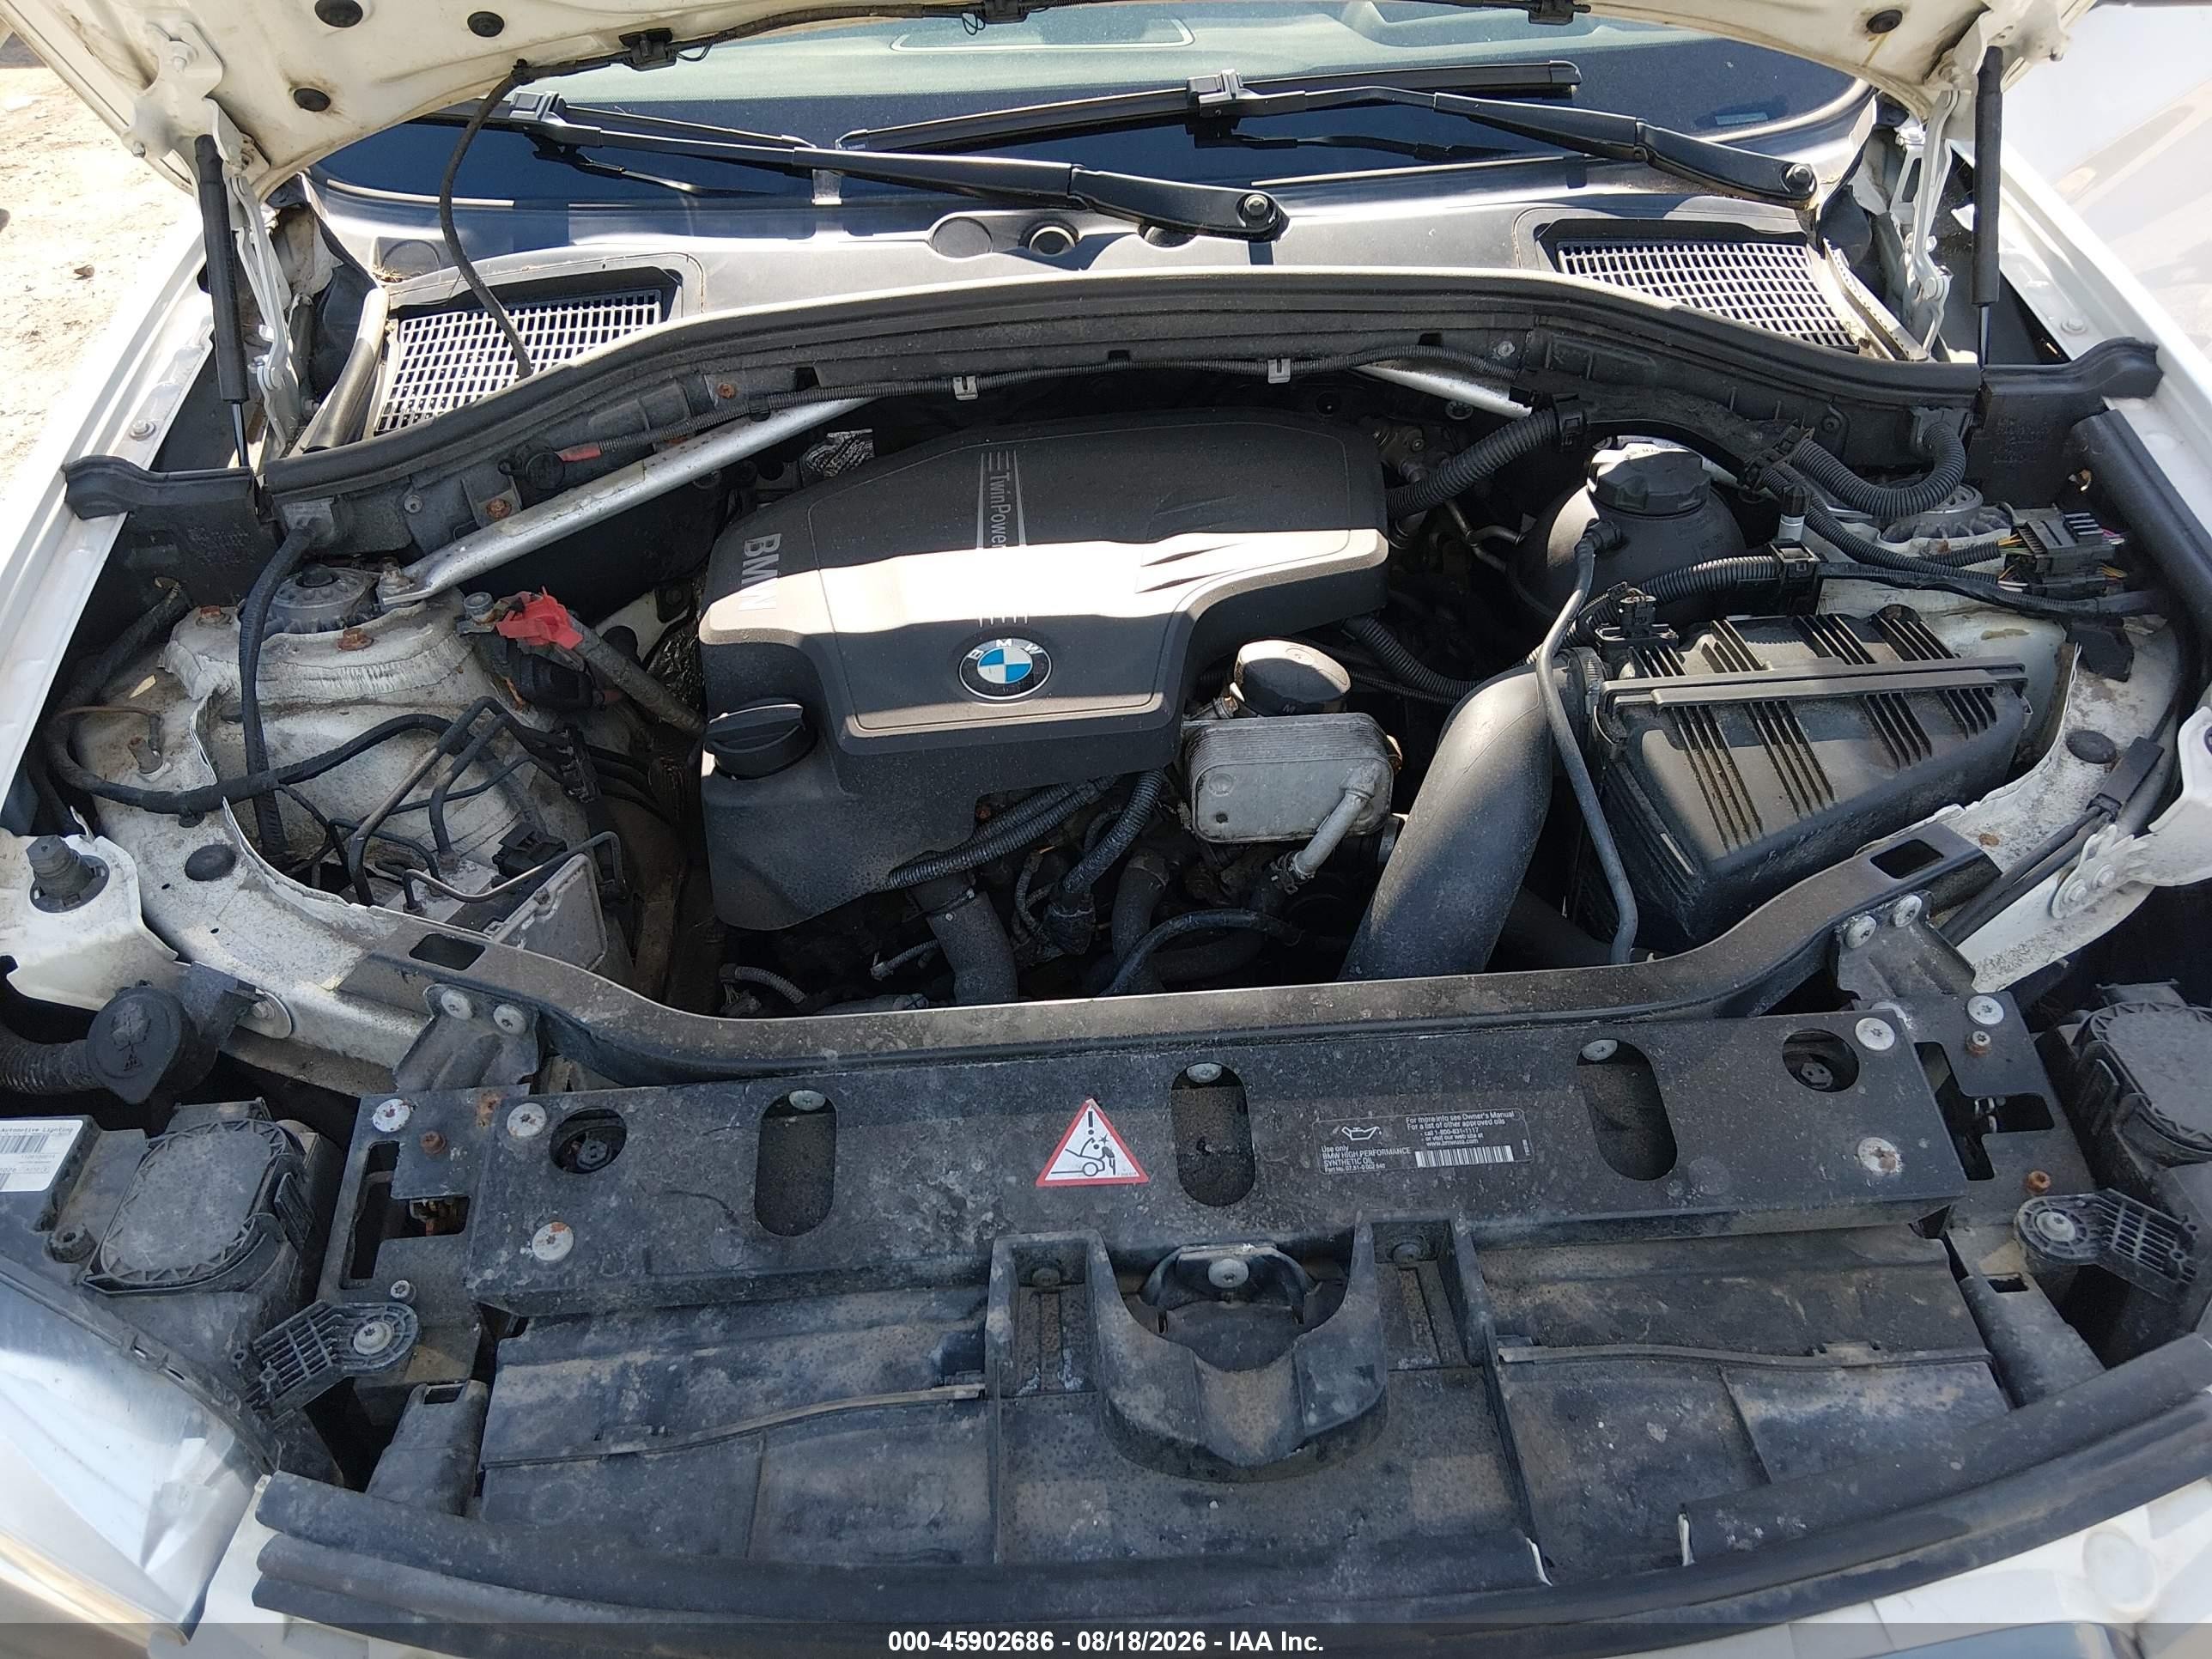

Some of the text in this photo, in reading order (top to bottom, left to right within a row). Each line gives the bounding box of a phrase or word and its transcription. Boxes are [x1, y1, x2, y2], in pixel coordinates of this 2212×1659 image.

[967, 638, 1044, 660] BMW
[1462, 1119, 1493, 1127] approved
[1322, 1147, 1411, 1160] BMW HIGH PERFORMANCE
[1323, 1158, 1362, 1167] SYNTHETIC
